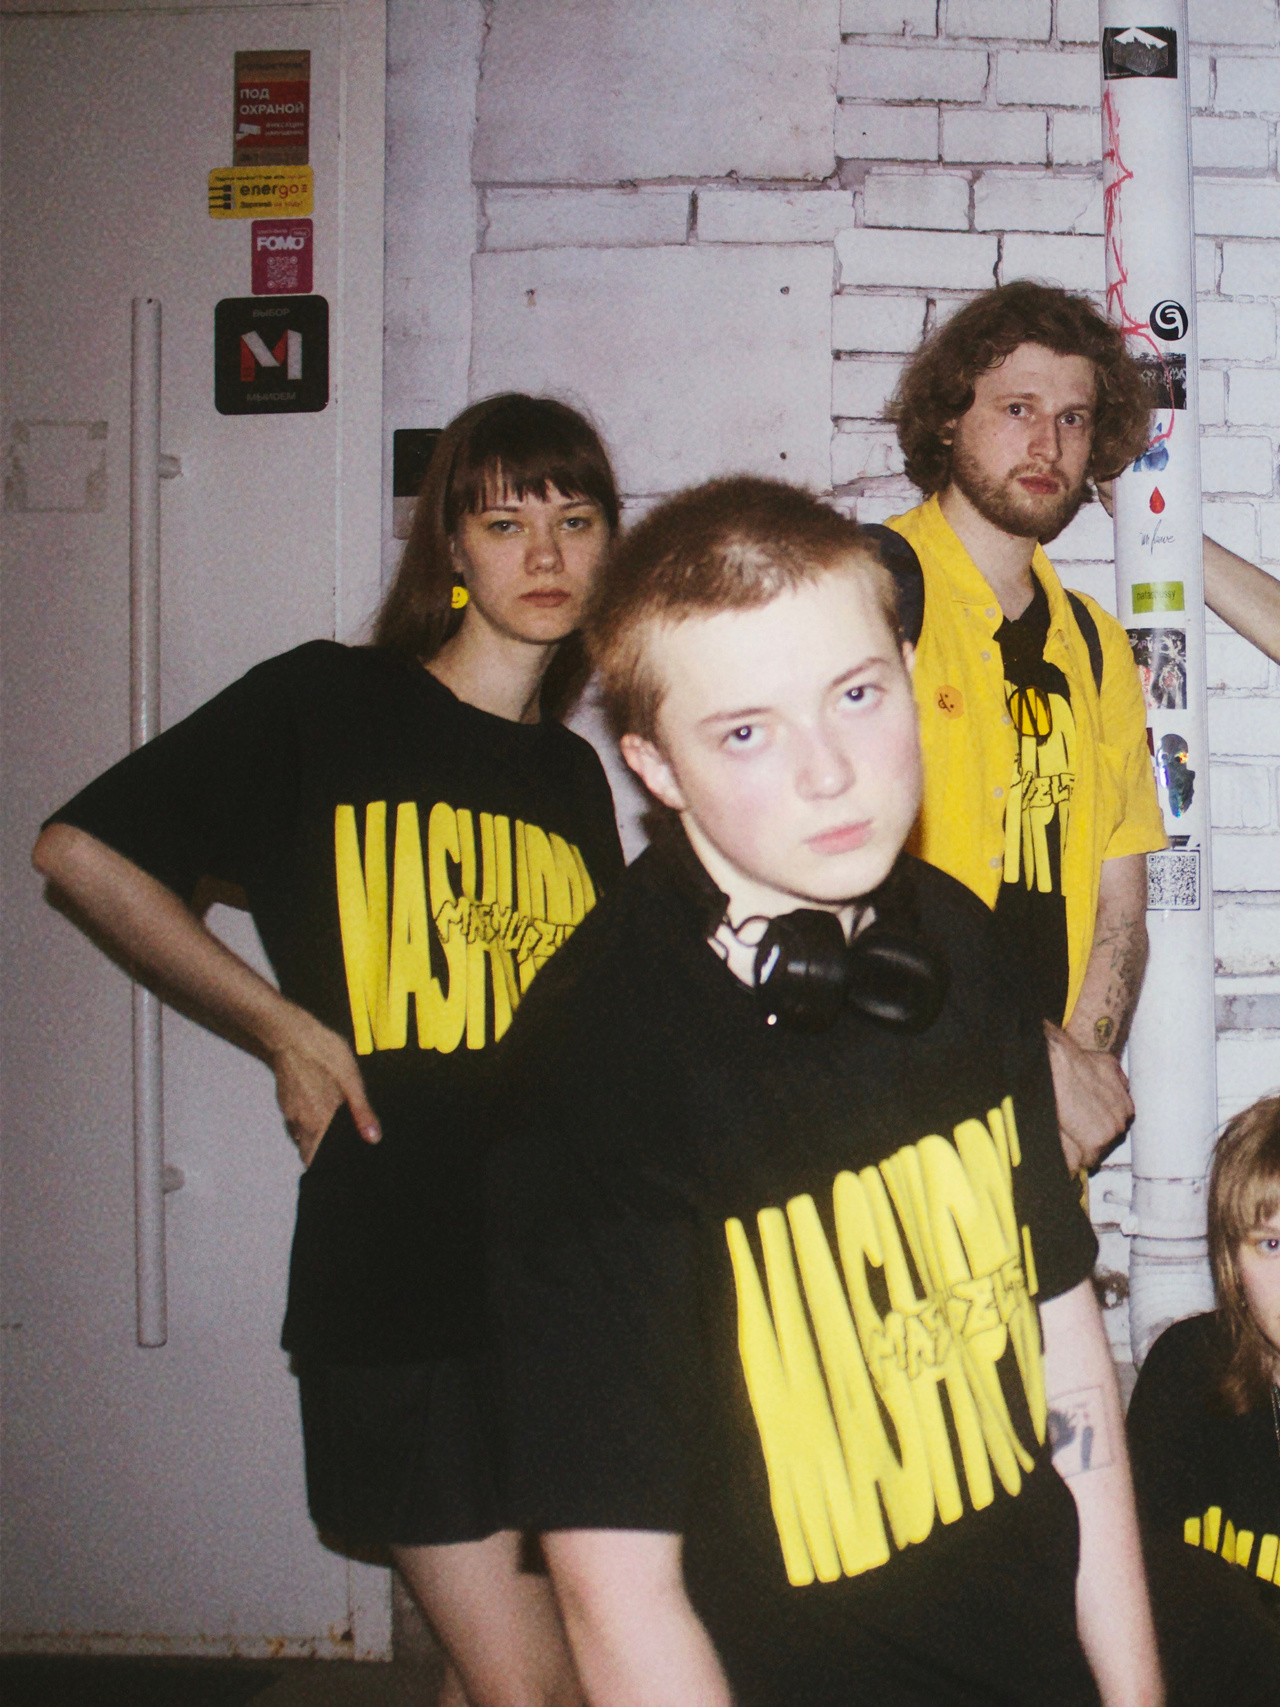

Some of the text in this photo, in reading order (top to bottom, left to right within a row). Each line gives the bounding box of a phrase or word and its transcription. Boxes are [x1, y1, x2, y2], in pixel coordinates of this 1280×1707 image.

[240, 88, 270, 100] ПОД
[240, 103, 304, 116] ОХРАНОЙ
[240, 184, 299, 199] energo
[256, 236, 305, 252] FOMO
